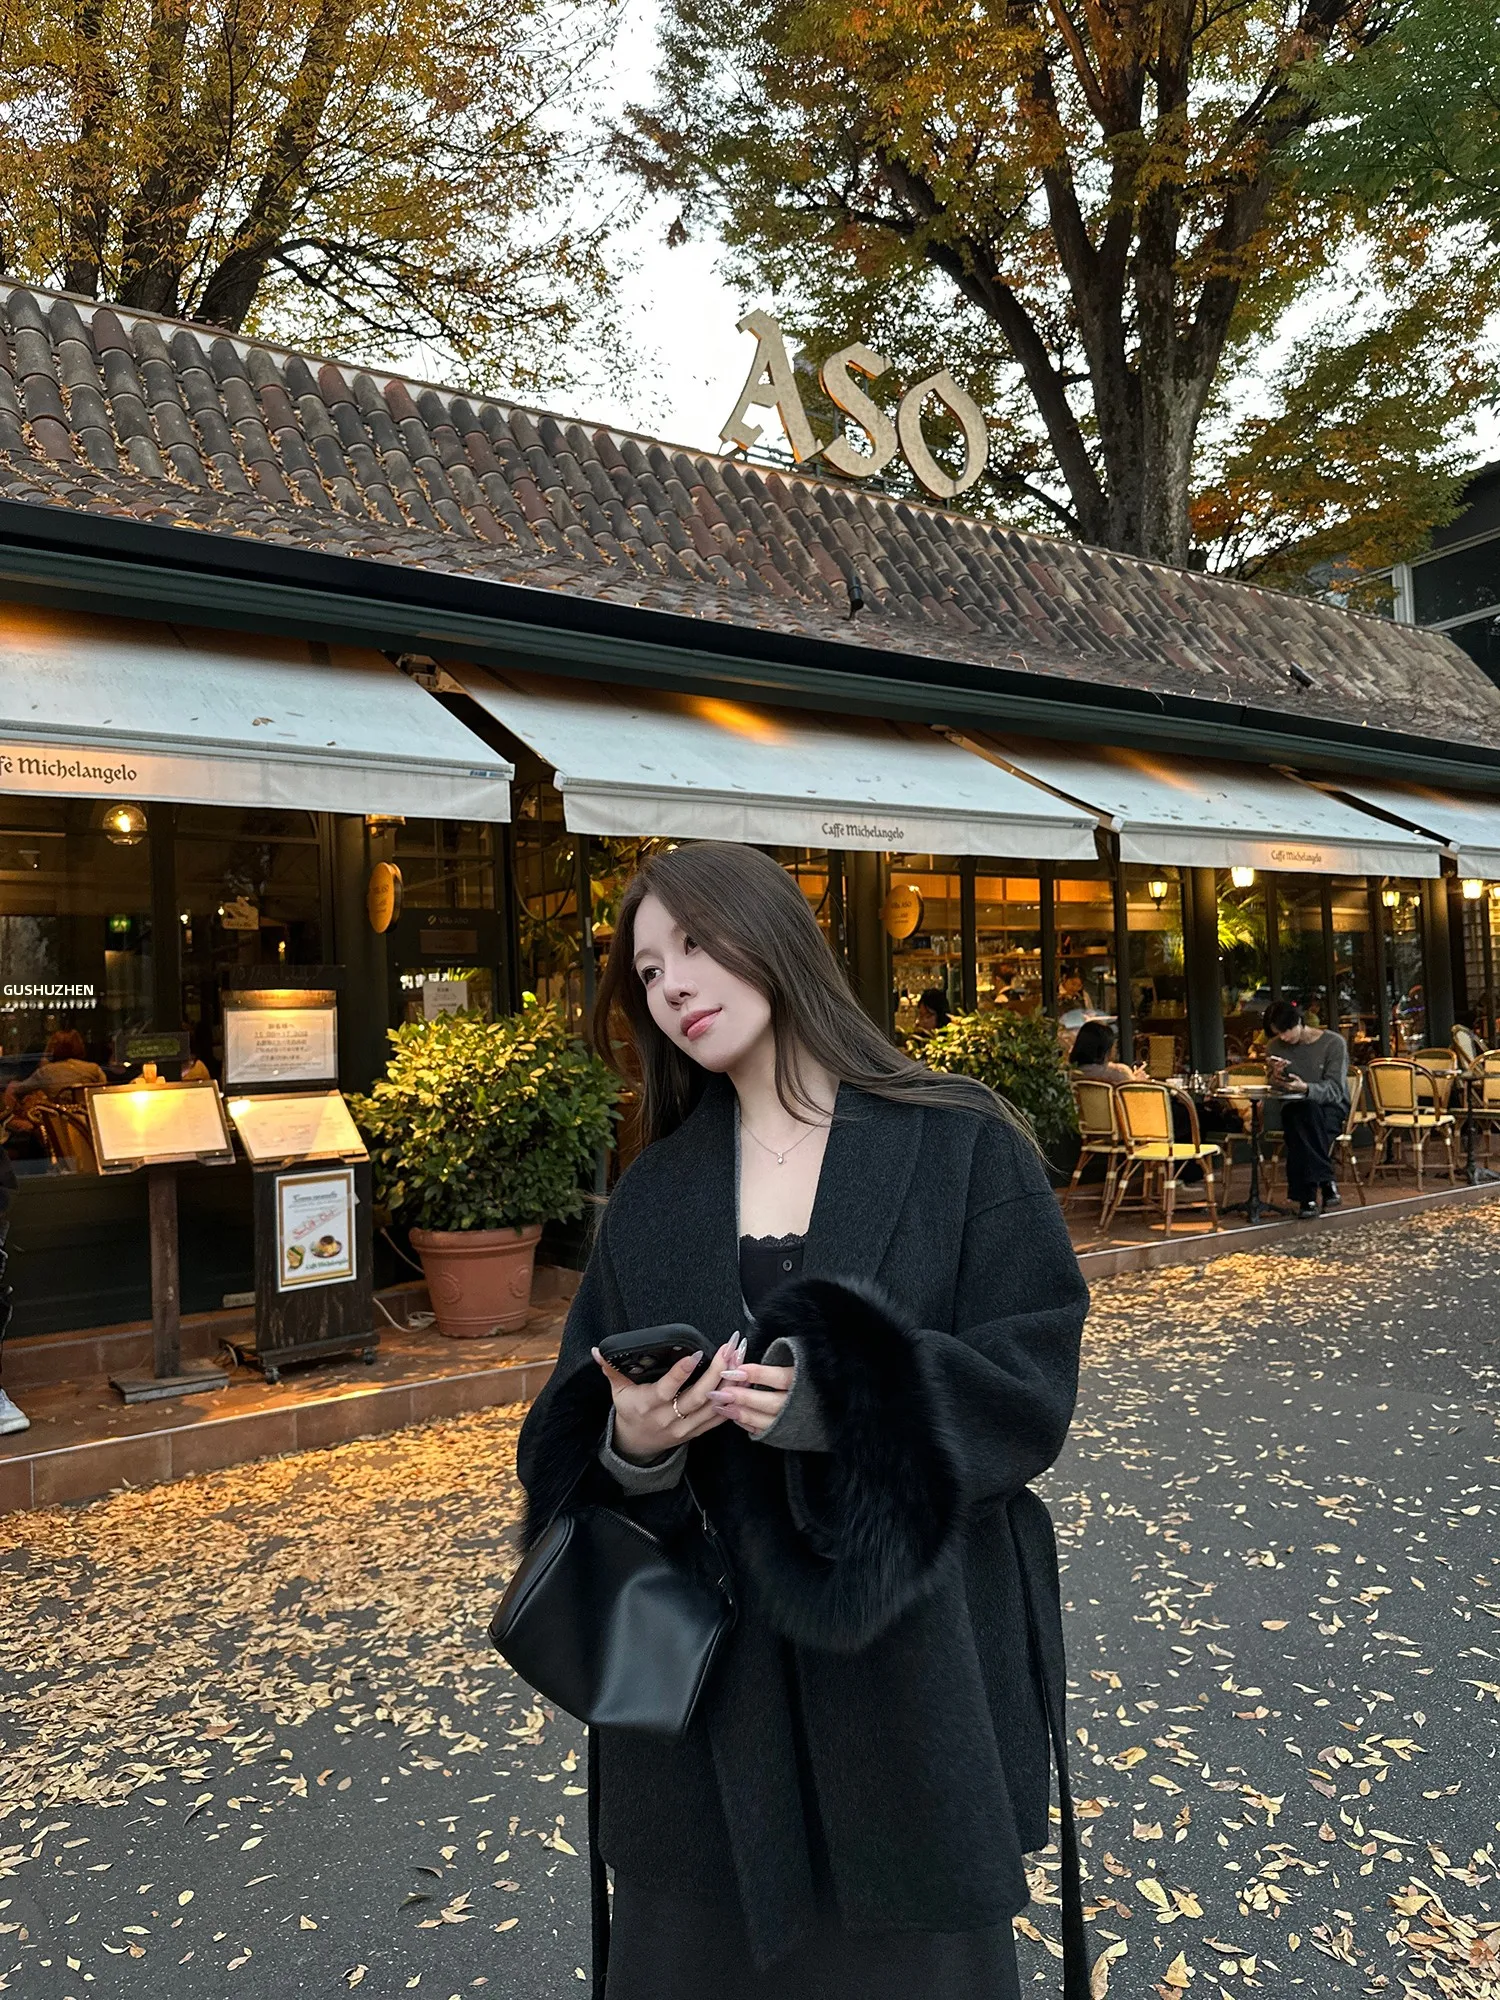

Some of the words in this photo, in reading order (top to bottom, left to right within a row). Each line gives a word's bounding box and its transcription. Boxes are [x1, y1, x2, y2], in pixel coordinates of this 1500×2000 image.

[718, 308, 989, 499] ASO
[17, 757, 137, 784] Michelangelo
[846, 824, 904, 842] Michelangelo
